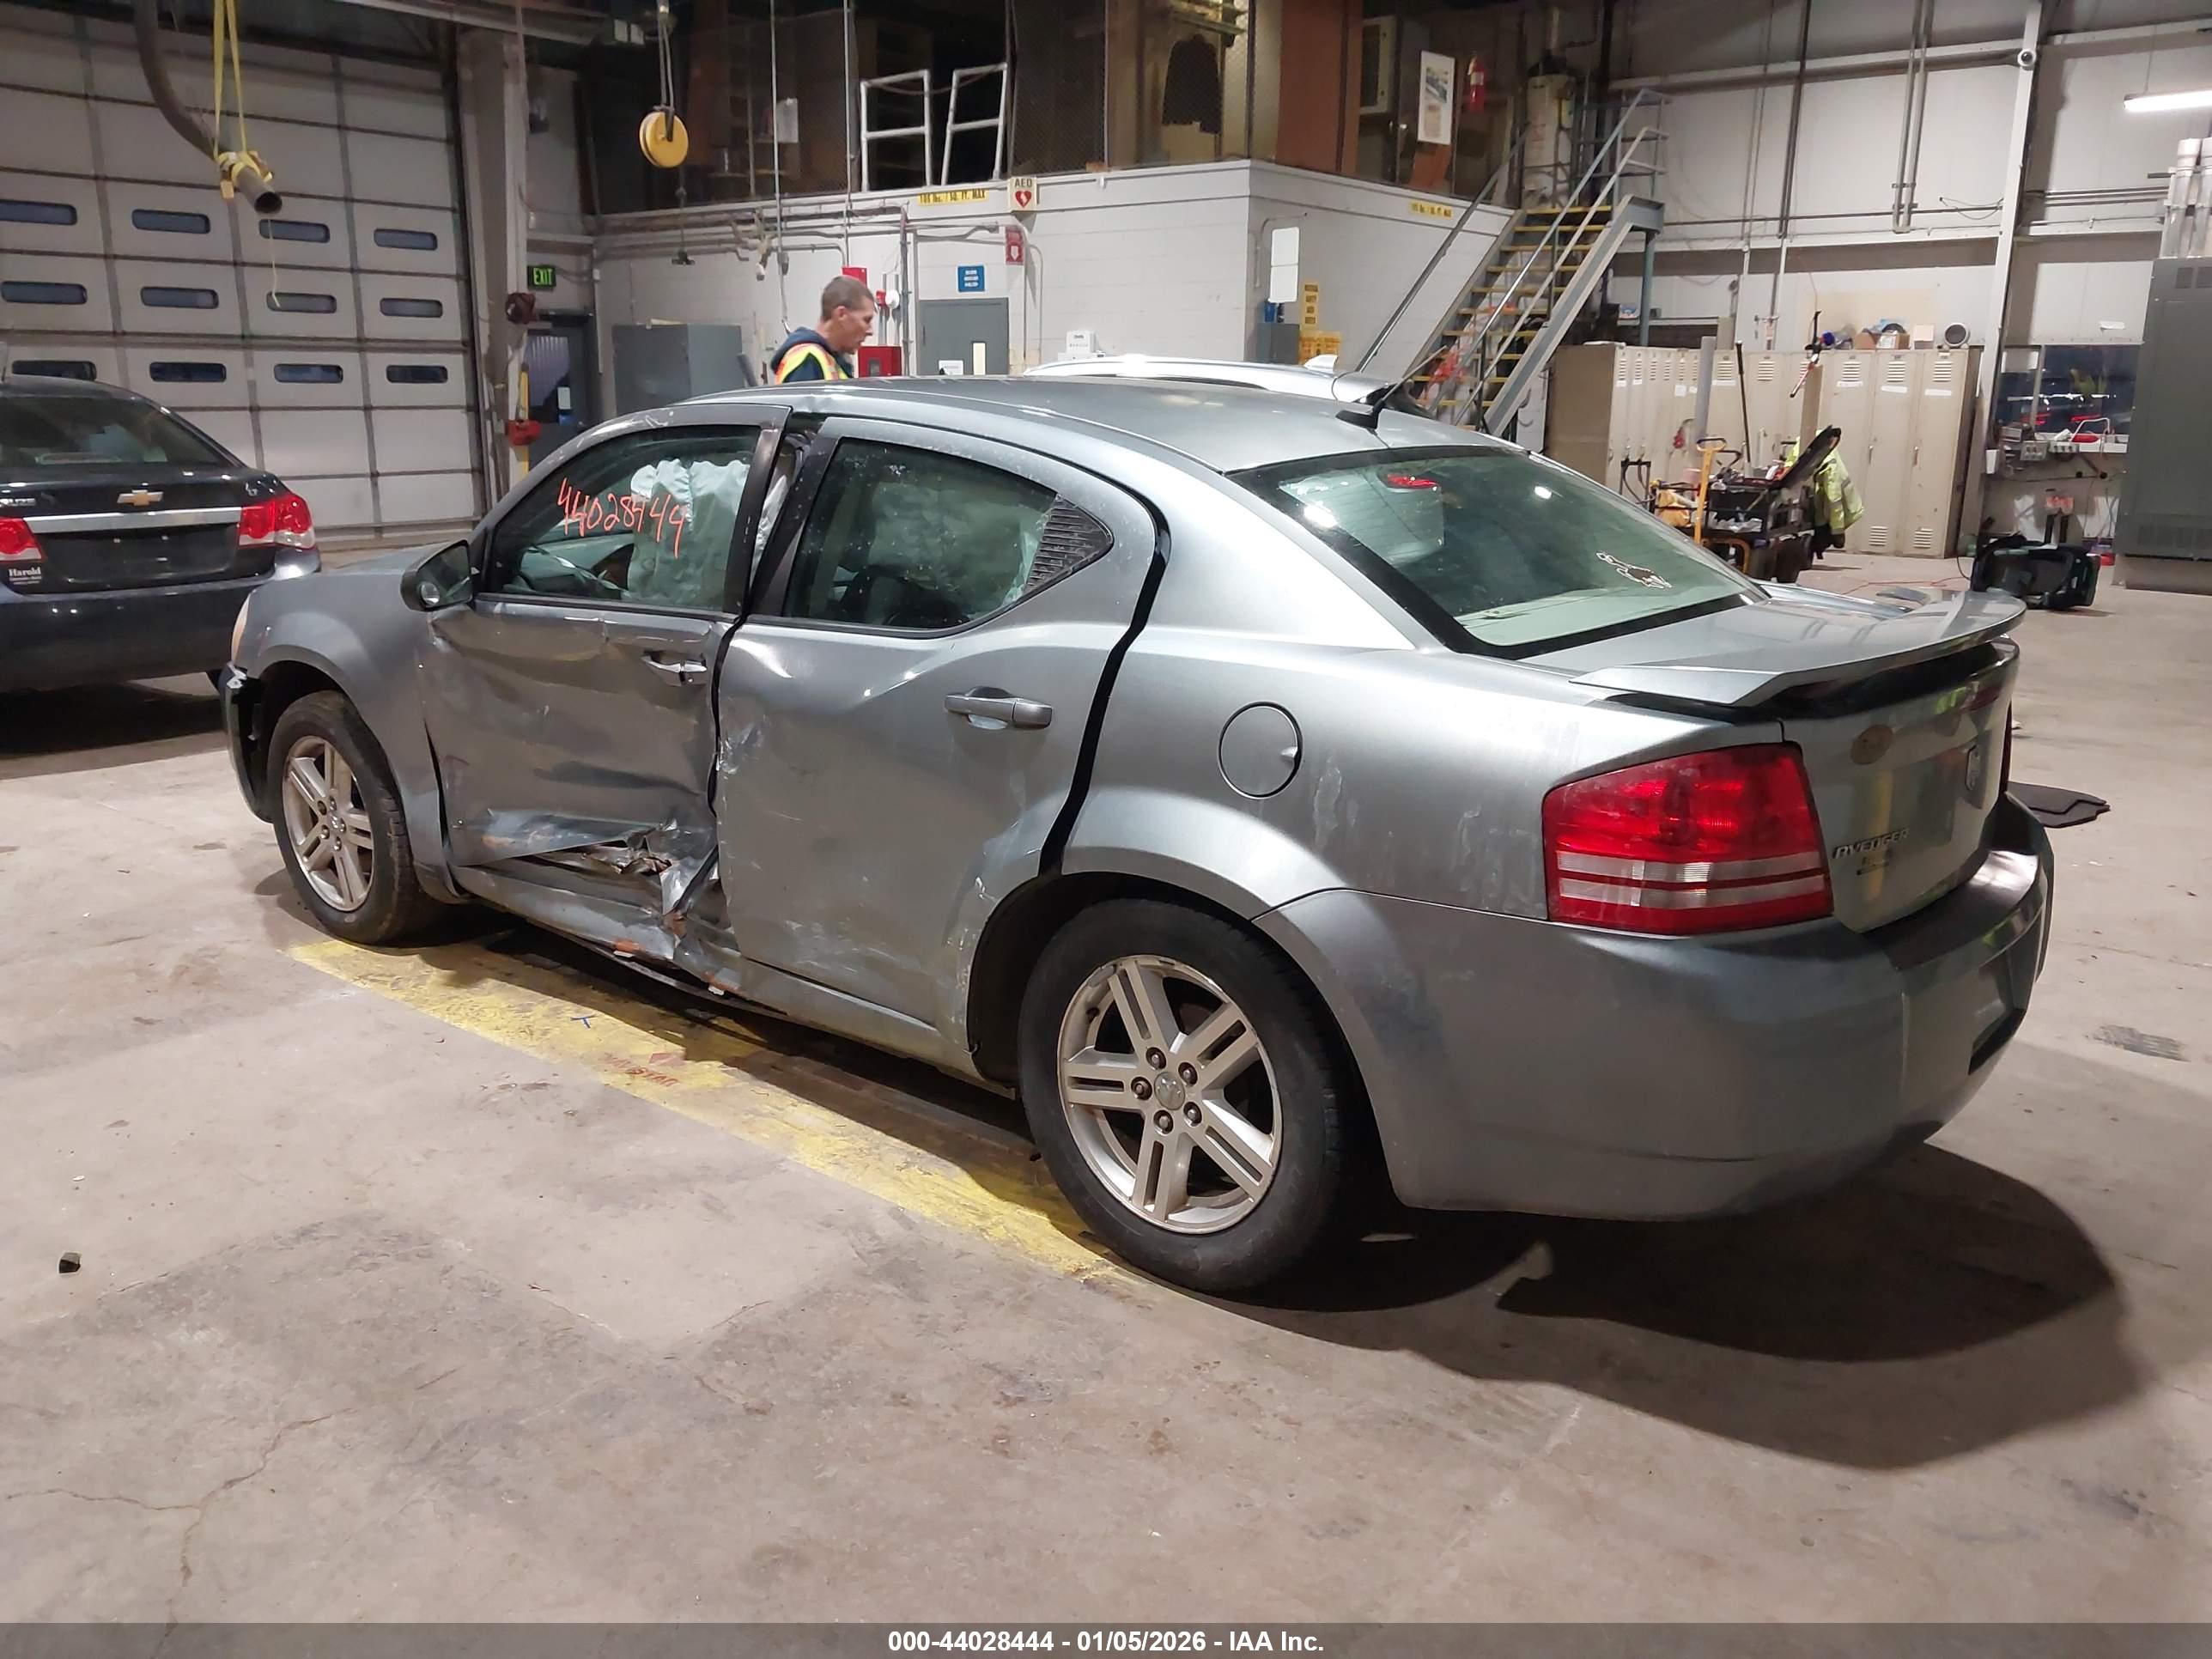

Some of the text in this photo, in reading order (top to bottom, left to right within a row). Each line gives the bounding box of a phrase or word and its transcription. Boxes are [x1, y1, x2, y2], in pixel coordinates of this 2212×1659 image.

[1014, 178, 1033, 187] AED
[972, 188, 986, 199] MAX
[532, 267, 553, 285] EXIT
[8, 567, 41, 577] Harold
[1832, 827, 1910, 860] AVENGER
